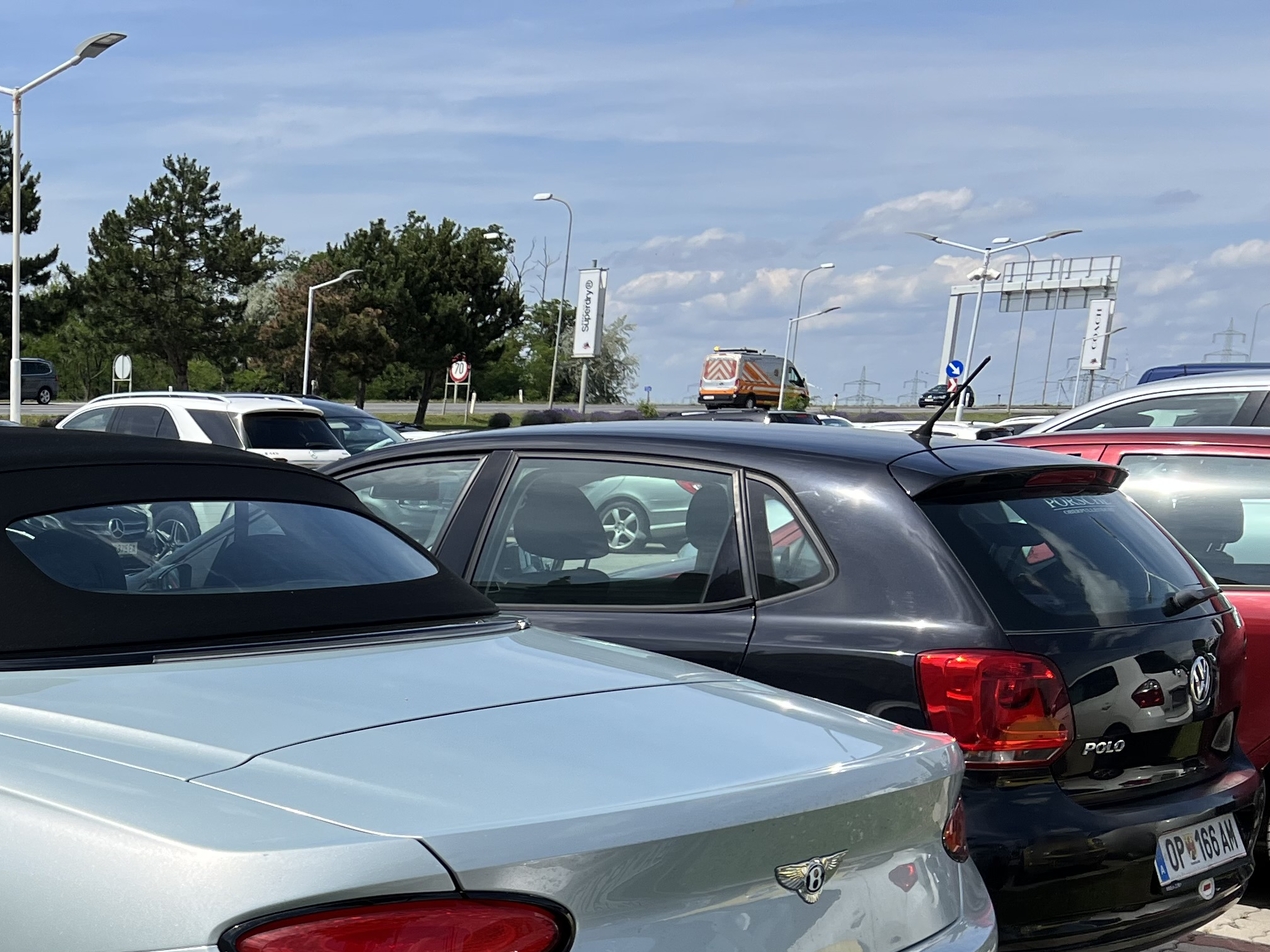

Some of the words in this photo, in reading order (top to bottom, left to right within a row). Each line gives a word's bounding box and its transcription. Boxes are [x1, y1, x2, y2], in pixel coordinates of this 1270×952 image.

[454, 362, 465, 375] 70
[1082, 739, 1126, 756] POLO
[1165, 836, 1185, 872] OP
